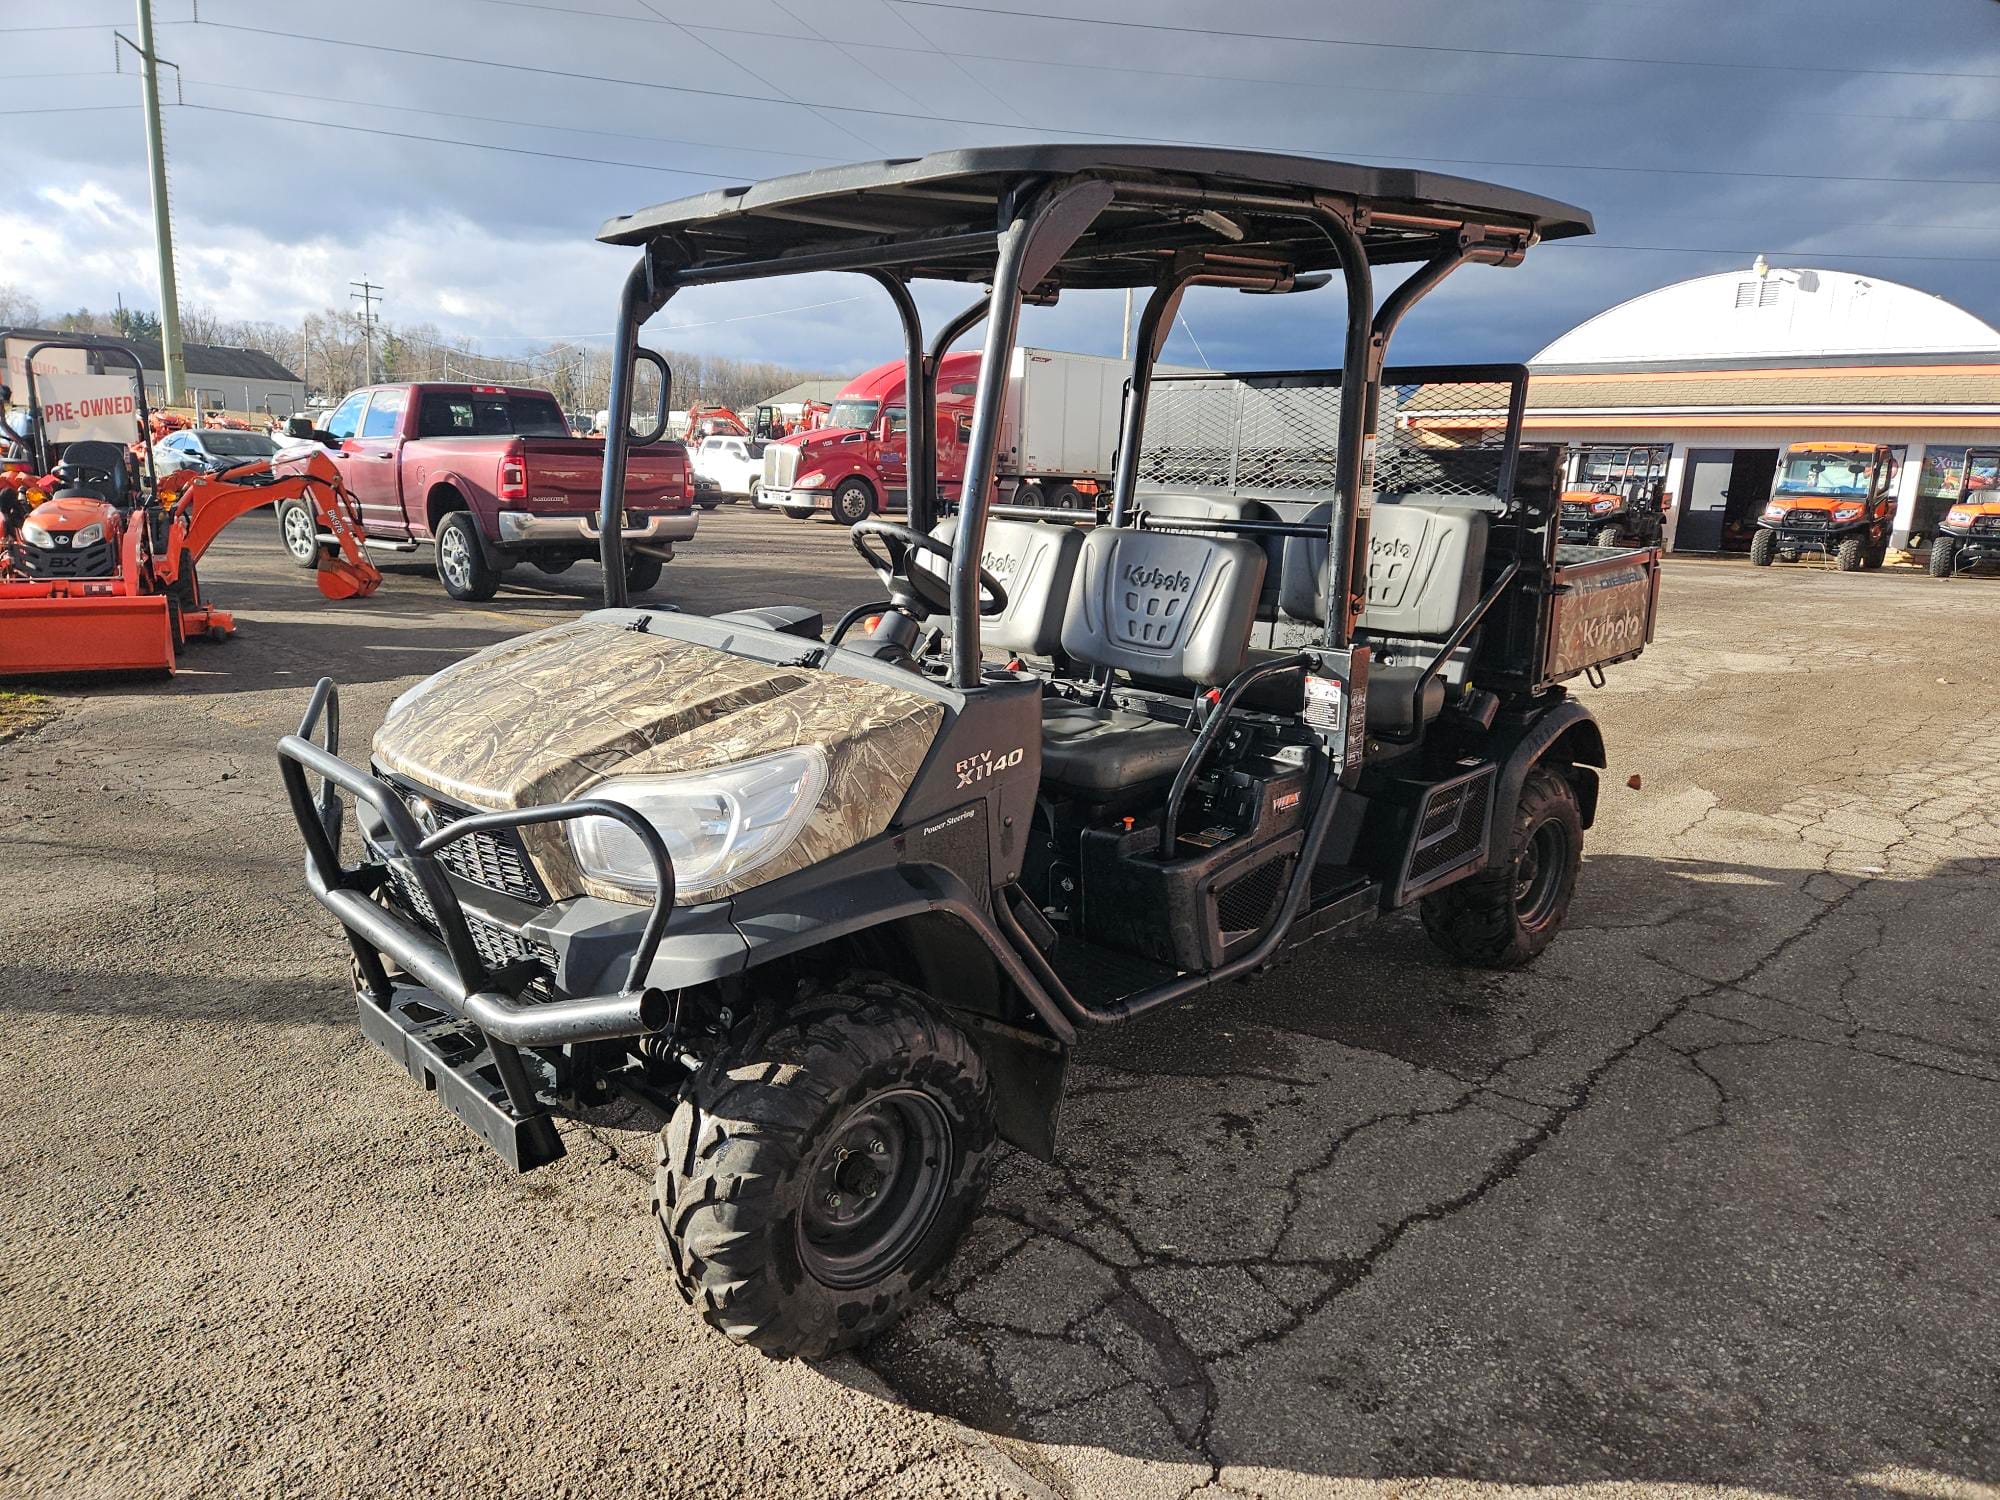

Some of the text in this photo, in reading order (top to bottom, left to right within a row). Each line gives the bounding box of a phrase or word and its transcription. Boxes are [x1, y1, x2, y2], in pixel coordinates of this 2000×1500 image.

[45, 396, 133, 423] PRE-OWNED
[49, 557, 79, 568] BX
[1124, 564, 1190, 593] Kubota
[1583, 609, 1642, 648] Kubota
[956, 750, 992, 772] RTV
[956, 748, 1024, 789] X1140
[923, 809, 975, 836] Power Steering
